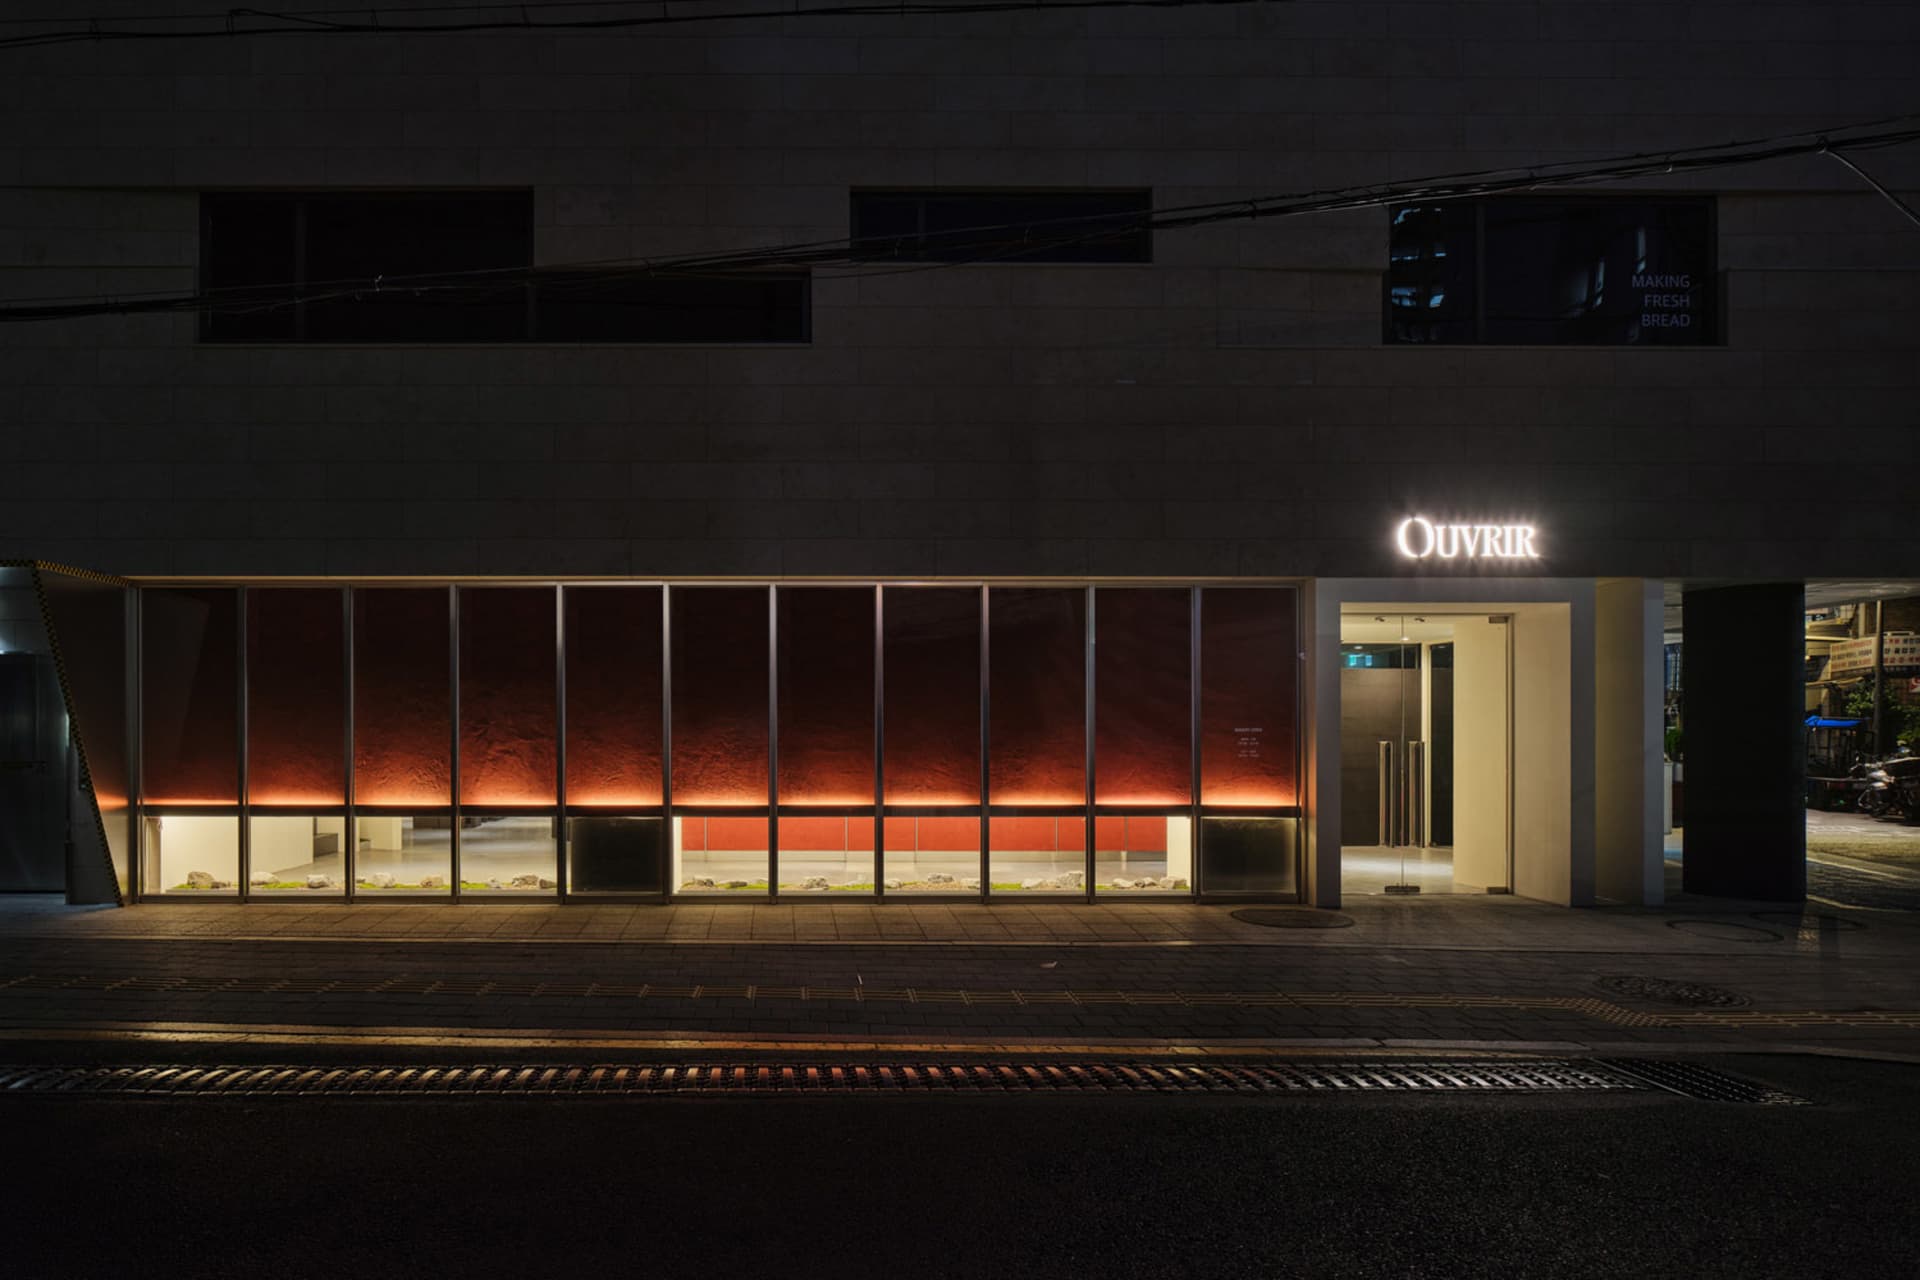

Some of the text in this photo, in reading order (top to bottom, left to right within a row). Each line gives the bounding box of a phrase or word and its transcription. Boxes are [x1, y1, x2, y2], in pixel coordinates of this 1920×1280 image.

[1632, 274, 1691, 288] MAKING
[1644, 294, 1691, 308] FRESH
[1641, 313, 1691, 327] BREAD
[1396, 516, 1540, 559] OUVRIR
